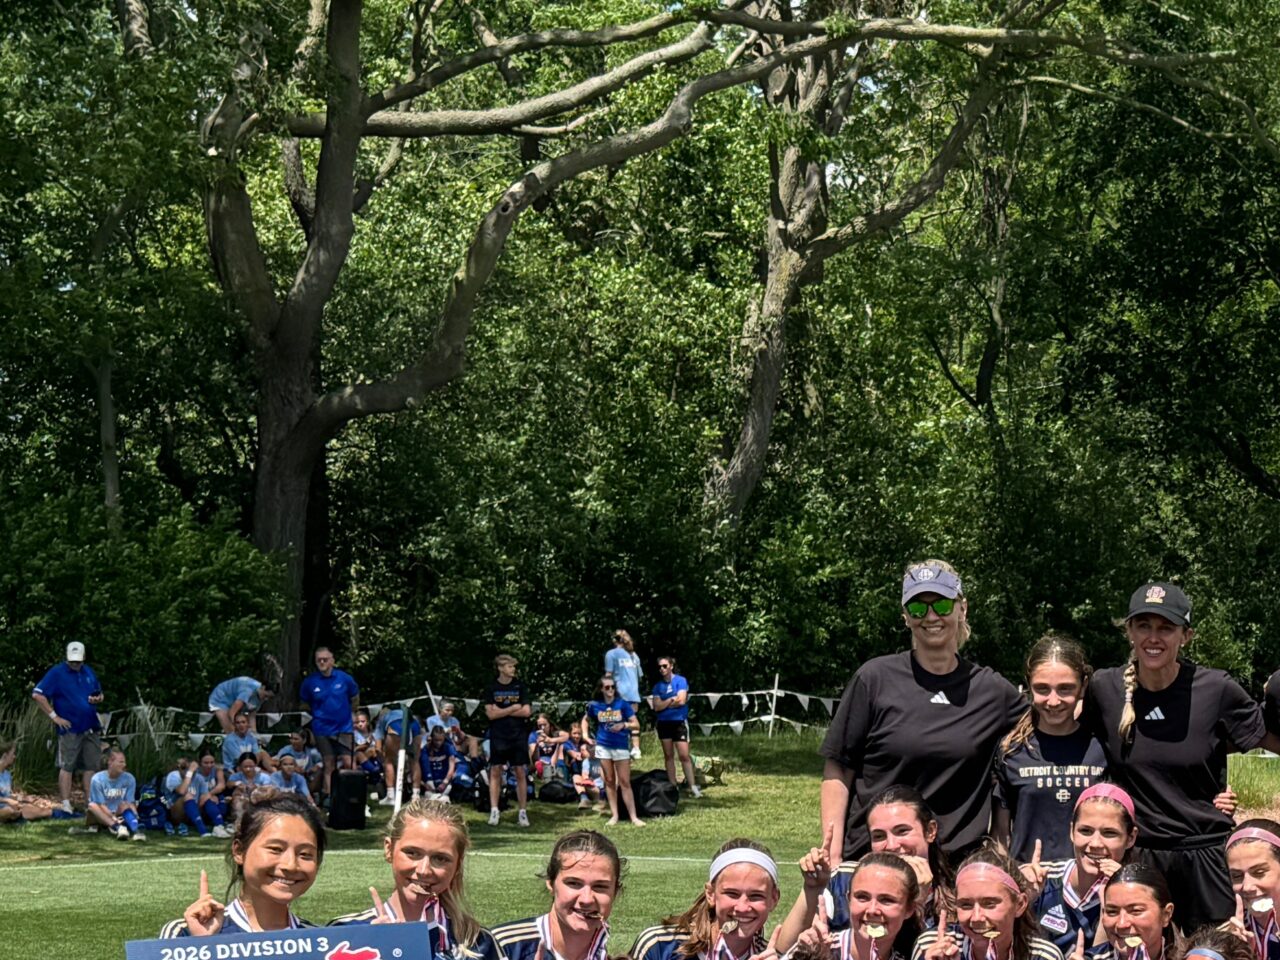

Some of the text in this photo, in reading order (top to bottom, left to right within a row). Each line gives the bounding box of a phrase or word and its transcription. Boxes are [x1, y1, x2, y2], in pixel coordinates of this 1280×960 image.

[1019, 766, 1051, 778] DETROIT
[1053, 765, 1089, 776] COUNTRY
[1037, 777, 1089, 788] SOCCER
[216, 938, 313, 960] DIVISION
[316, 936, 329, 952] 3
